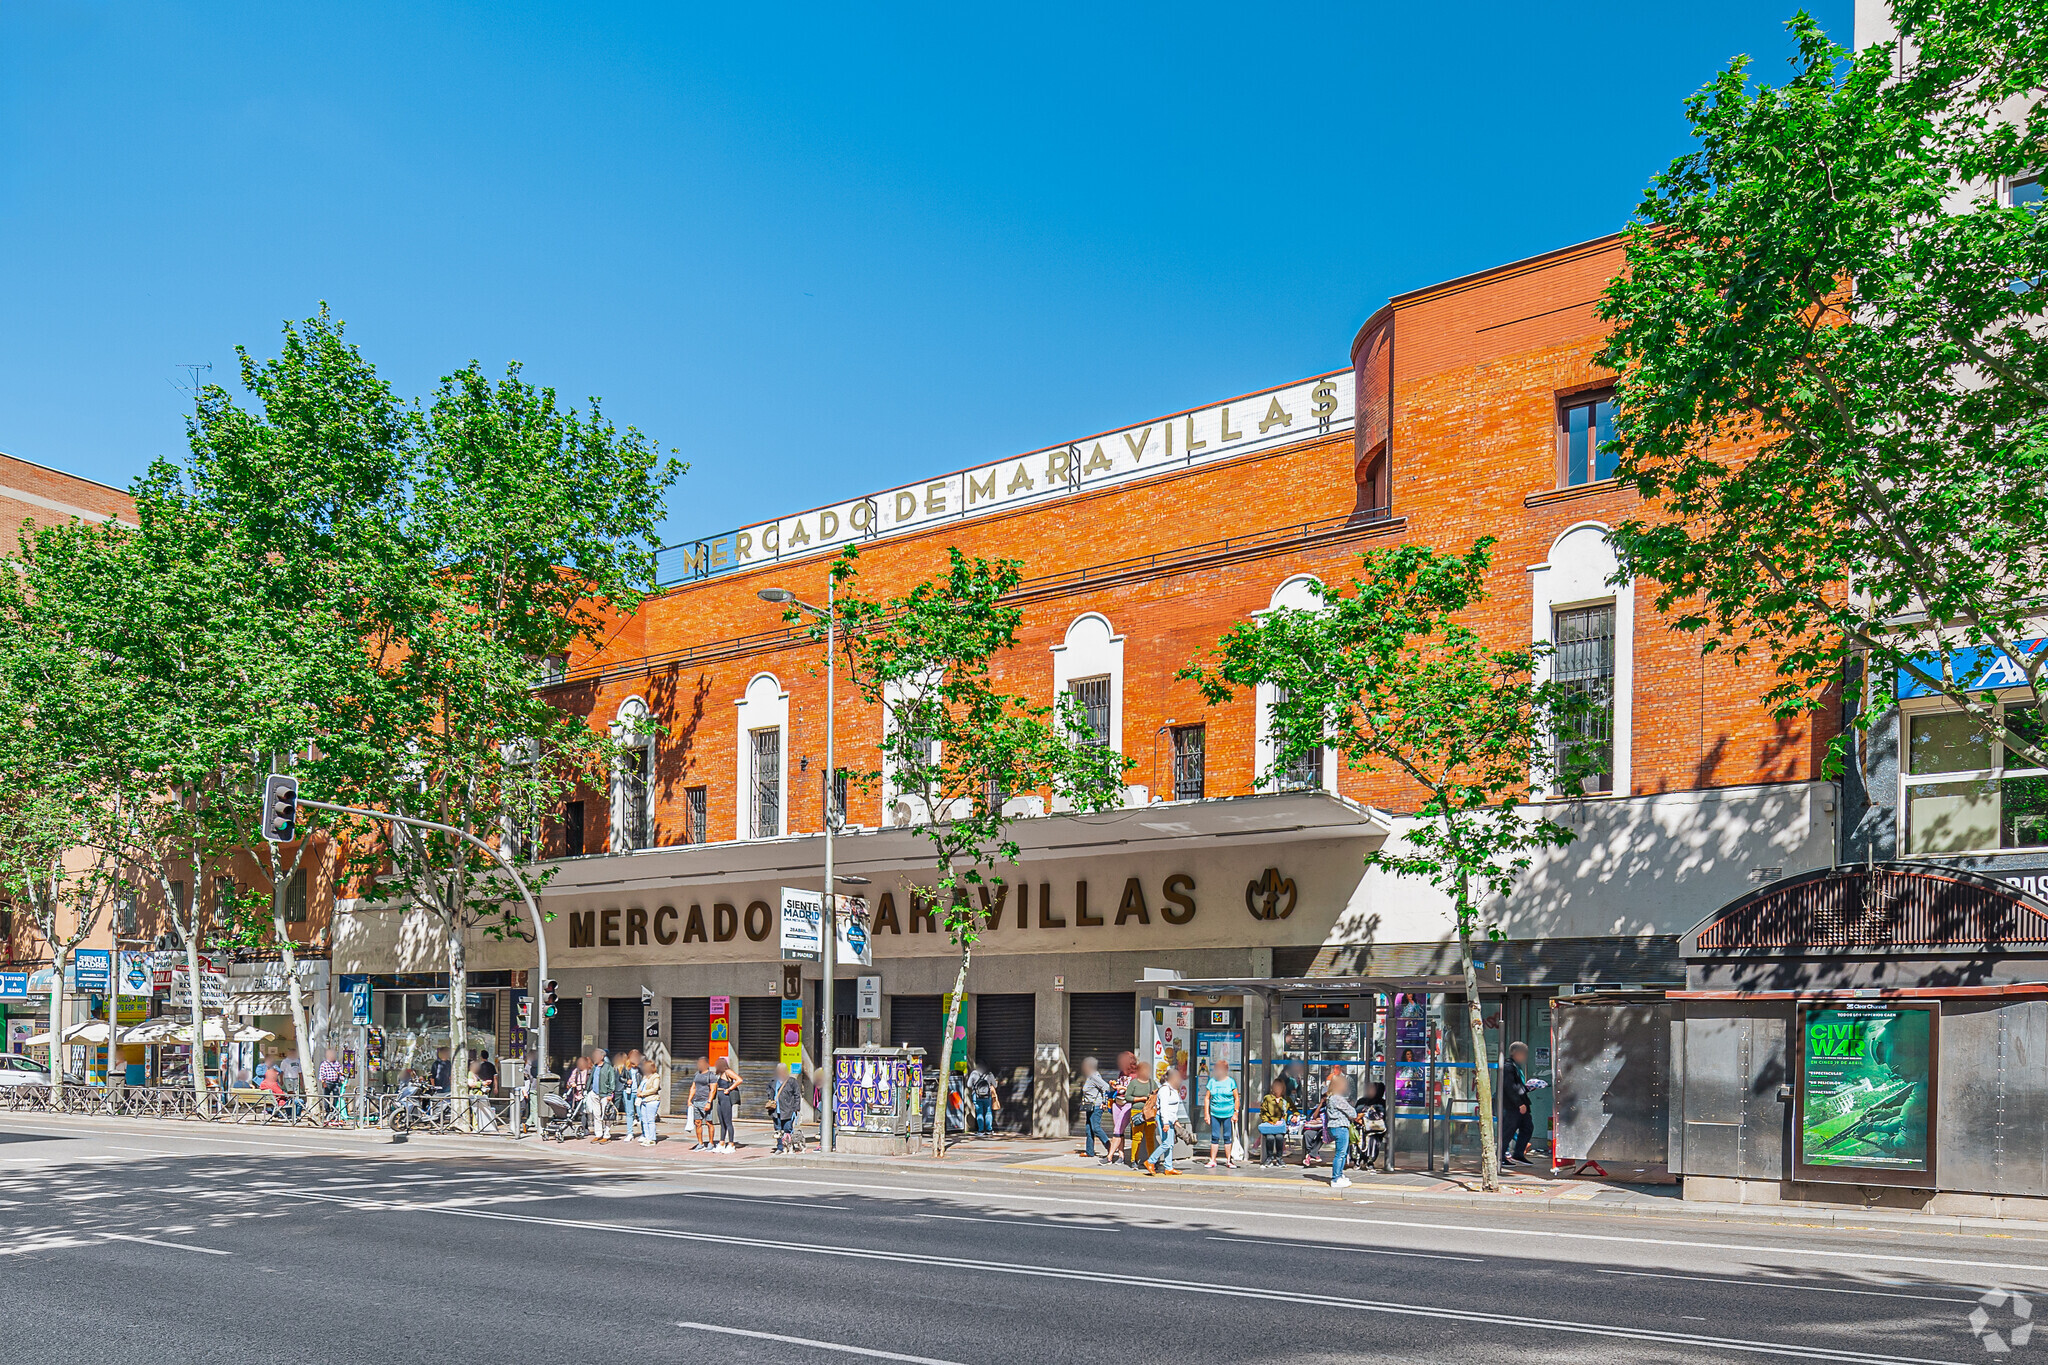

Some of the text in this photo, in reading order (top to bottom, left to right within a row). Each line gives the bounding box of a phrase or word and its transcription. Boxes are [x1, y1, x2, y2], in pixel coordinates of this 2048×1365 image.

[683, 381, 1338, 574] MERCADO DE MARAVILLAS
[786, 899, 819, 912] SIENTE
[783, 908, 820, 921] MADRID
[569, 900, 773, 948] MERCADO
[77, 961, 108, 969] MADRID
[79, 955, 107, 963] SIENTE
[1810, 1024, 1865, 1040] CIVIL
[1810, 1039, 1866, 1057] WAR
